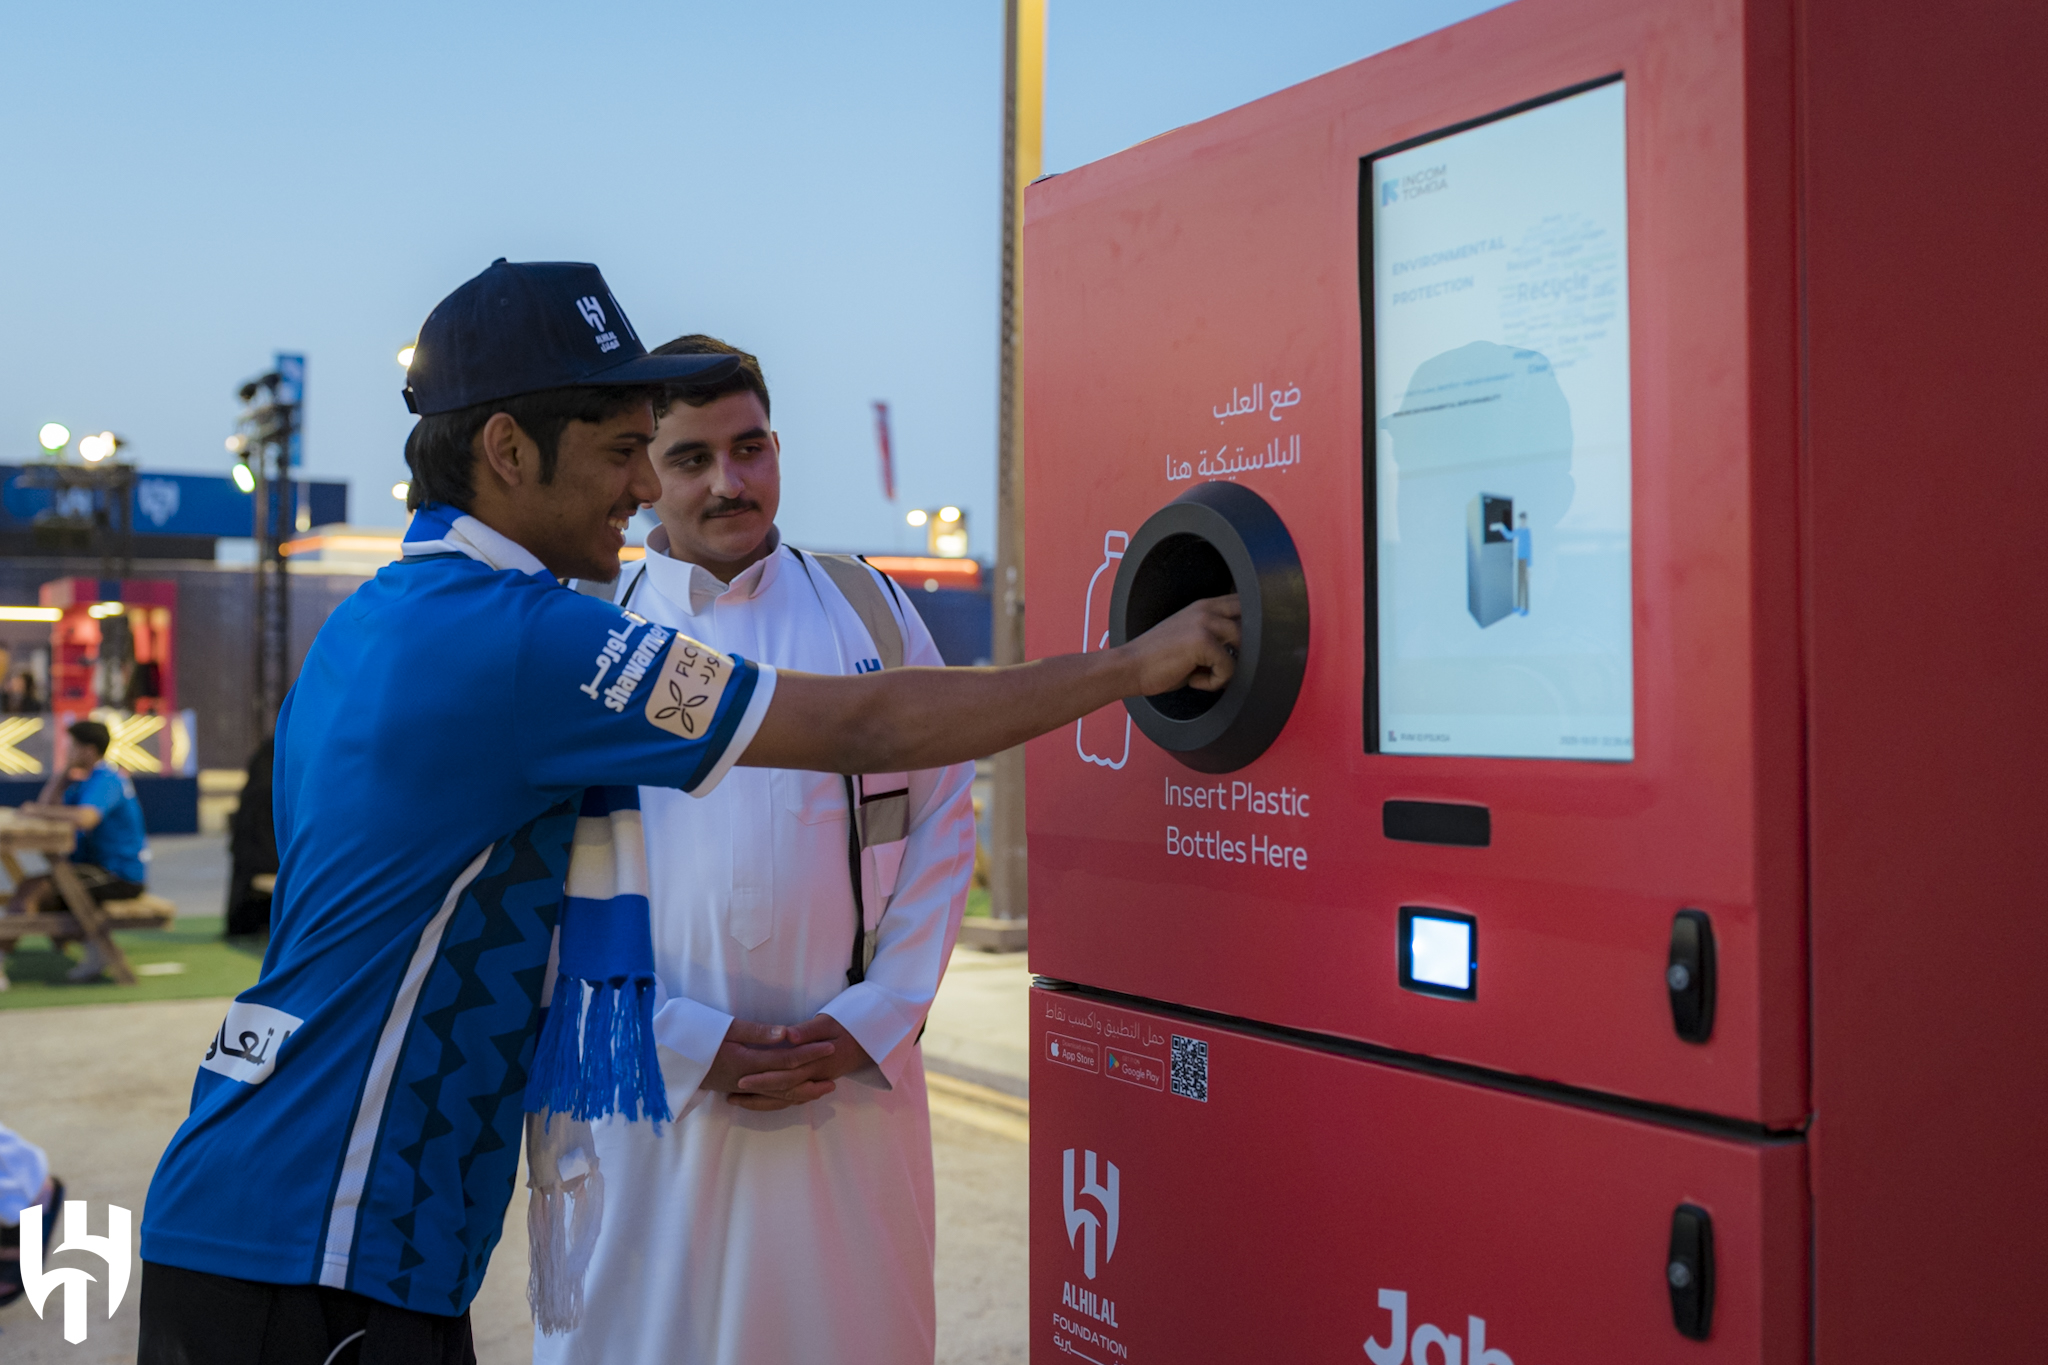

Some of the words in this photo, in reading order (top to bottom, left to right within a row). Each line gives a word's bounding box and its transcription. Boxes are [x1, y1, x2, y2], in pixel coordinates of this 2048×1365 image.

[1392, 275, 1475, 306] PROTECTION
[1213, 382, 1263, 425] العلب
[1269, 381, 1301, 421] ضع
[1166, 454, 1192, 481] هنا
[1198, 434, 1300, 482] البلاستيكية
[1165, 777, 1227, 810] Insert
[1231, 781, 1310, 818] Plastic
[1166, 826, 1247, 863] Bottles
[1251, 834, 1308, 870] Here
[1045, 1001, 1066, 1021] نقاط
[1103, 1019, 1140, 1039] التطبيق
[1142, 1025, 1165, 1047] حمل
[1062, 1048, 1076, 1062] App
[1076, 1052, 1095, 1066] Store
[1121, 1063, 1145, 1080] Google
[1146, 1069, 1160, 1085] Play
[1062, 1280, 1119, 1328] ALHILAL
[1053, 1312, 1127, 1359] FOUNDATION
